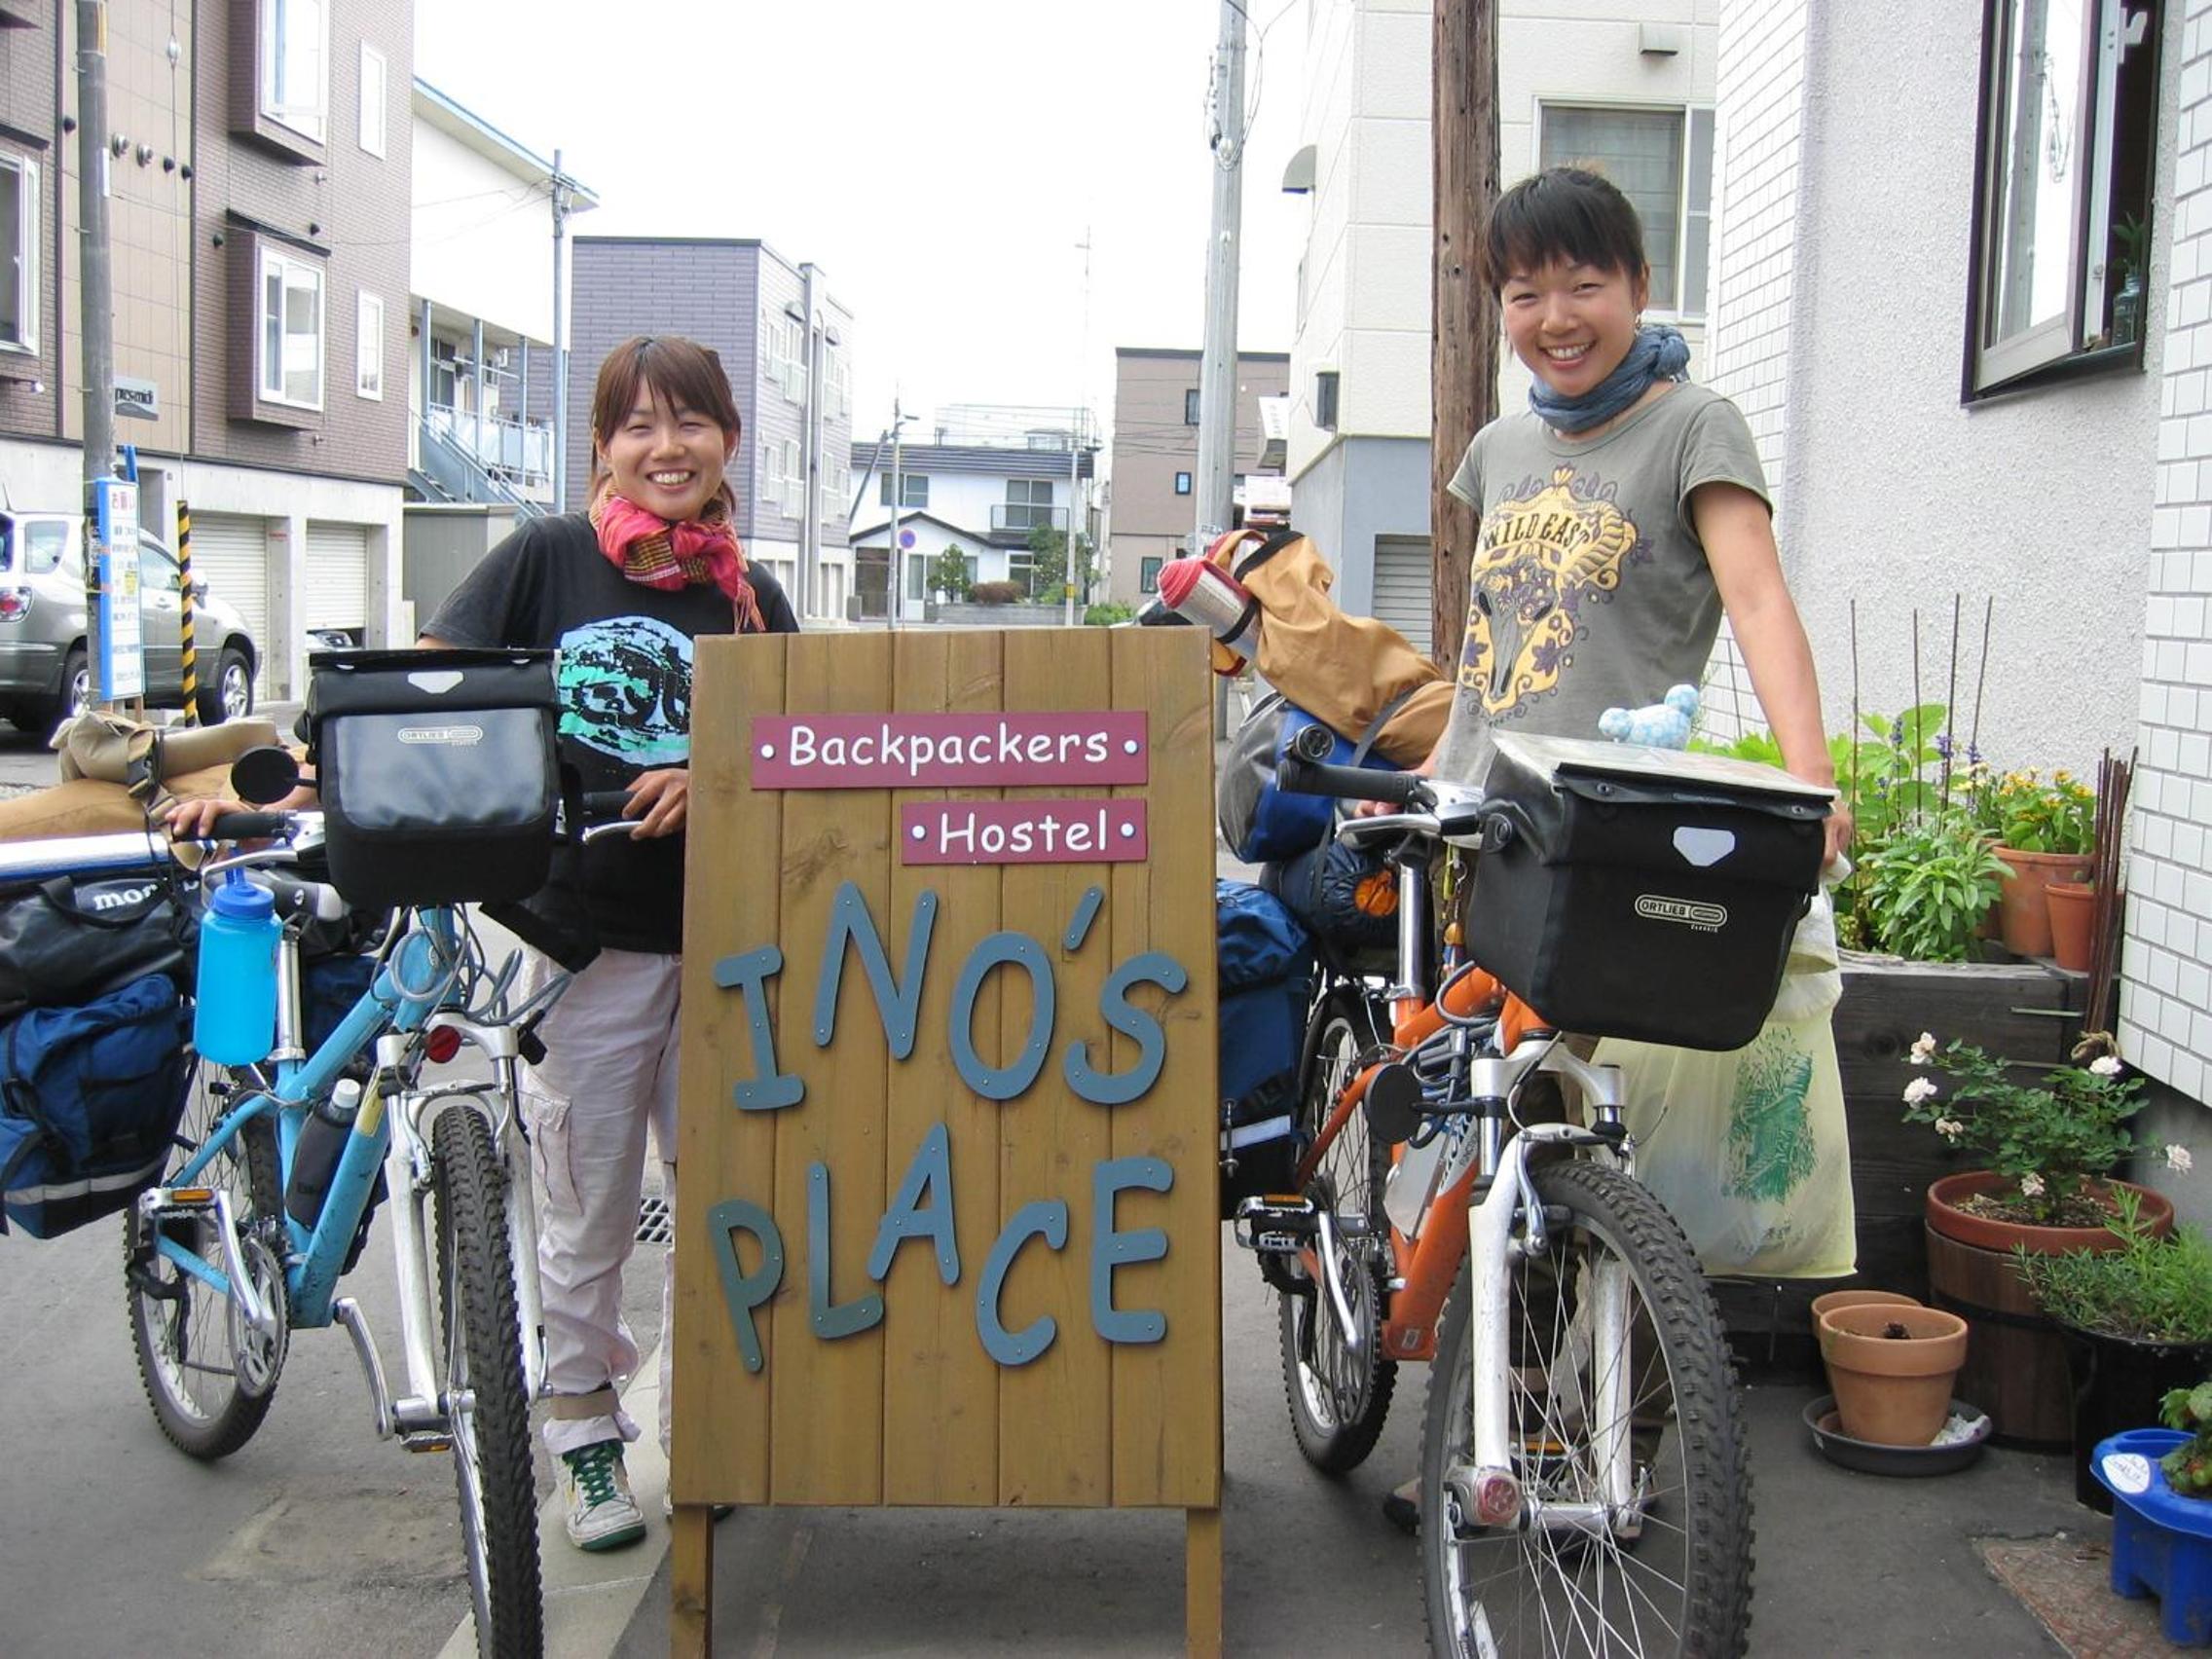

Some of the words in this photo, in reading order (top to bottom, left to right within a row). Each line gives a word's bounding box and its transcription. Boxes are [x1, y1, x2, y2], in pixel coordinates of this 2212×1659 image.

[1483, 513, 1539, 550] WILD
[790, 722, 1108, 776] Backpackers
[940, 808, 1107, 854] Hostel
[1641, 900, 1686, 916] ORTLIEB
[714, 881, 1188, 1111] INO'S
[708, 1122, 1174, 1373] PLACE
